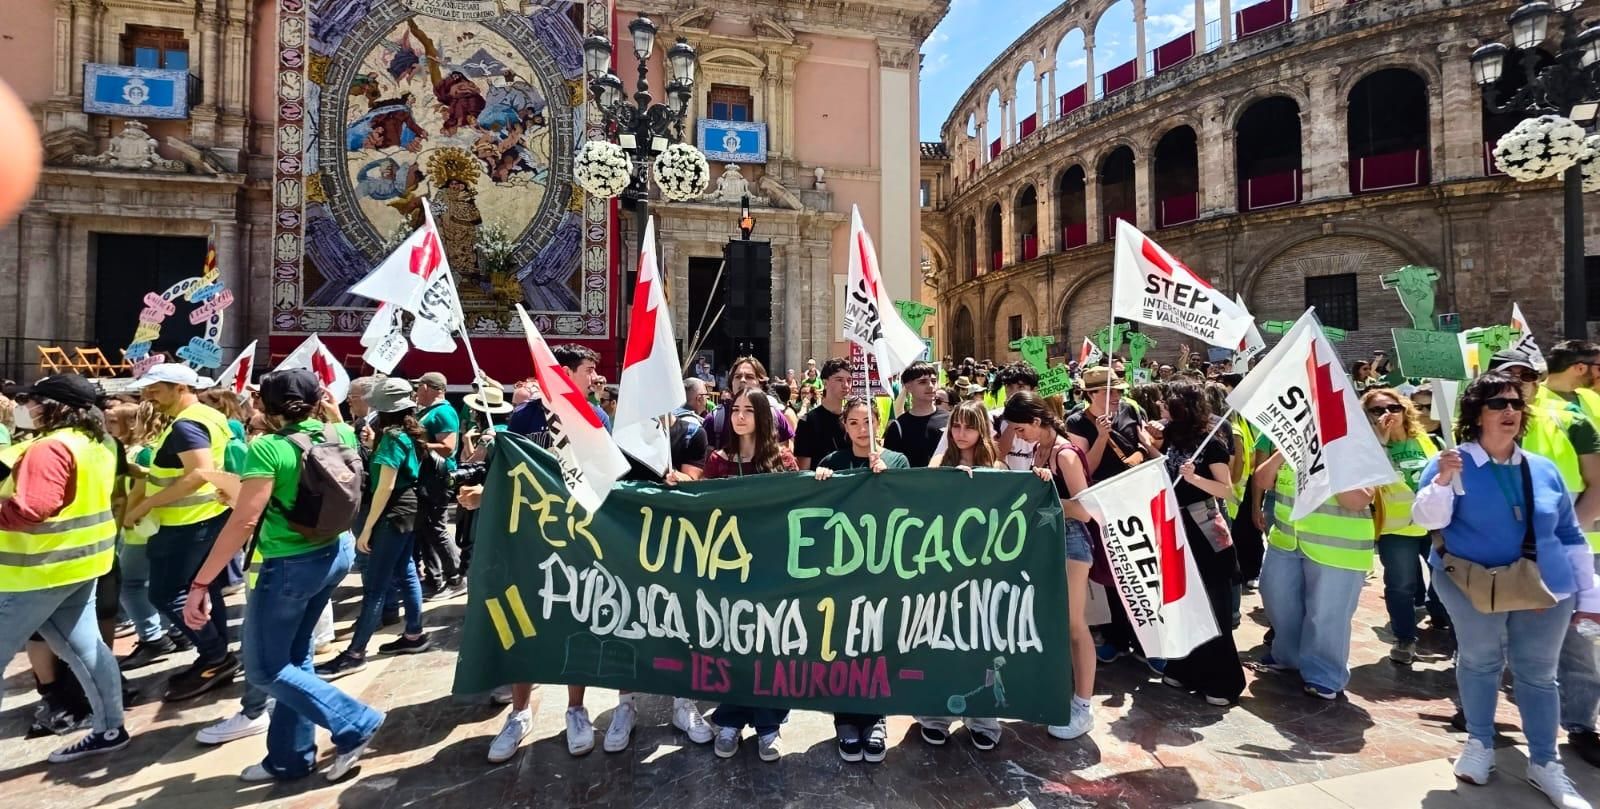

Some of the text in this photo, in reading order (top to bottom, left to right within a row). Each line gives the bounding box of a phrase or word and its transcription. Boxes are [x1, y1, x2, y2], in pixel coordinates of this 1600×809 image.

[1143, 297, 1221, 330] INTERSINDICAL
[1156, 310, 1215, 340] VALENCIANA
[1278, 386, 1325, 476] STEPV
[507, 461, 603, 560] PER
[639, 506, 753, 583] UNA
[787, 492, 1028, 579] EDUCACIÓ
[538, 551, 690, 643] PÚBLICA
[696, 588, 808, 655] DIGNA
[845, 595, 888, 657] EN
[897, 570, 1043, 655] VALENCIÀ
[1105, 542, 1147, 628] VALENCIANA
[1107, 523, 1157, 627] INTERSINDICAL
[691, 652, 892, 699] IES LAURONA
